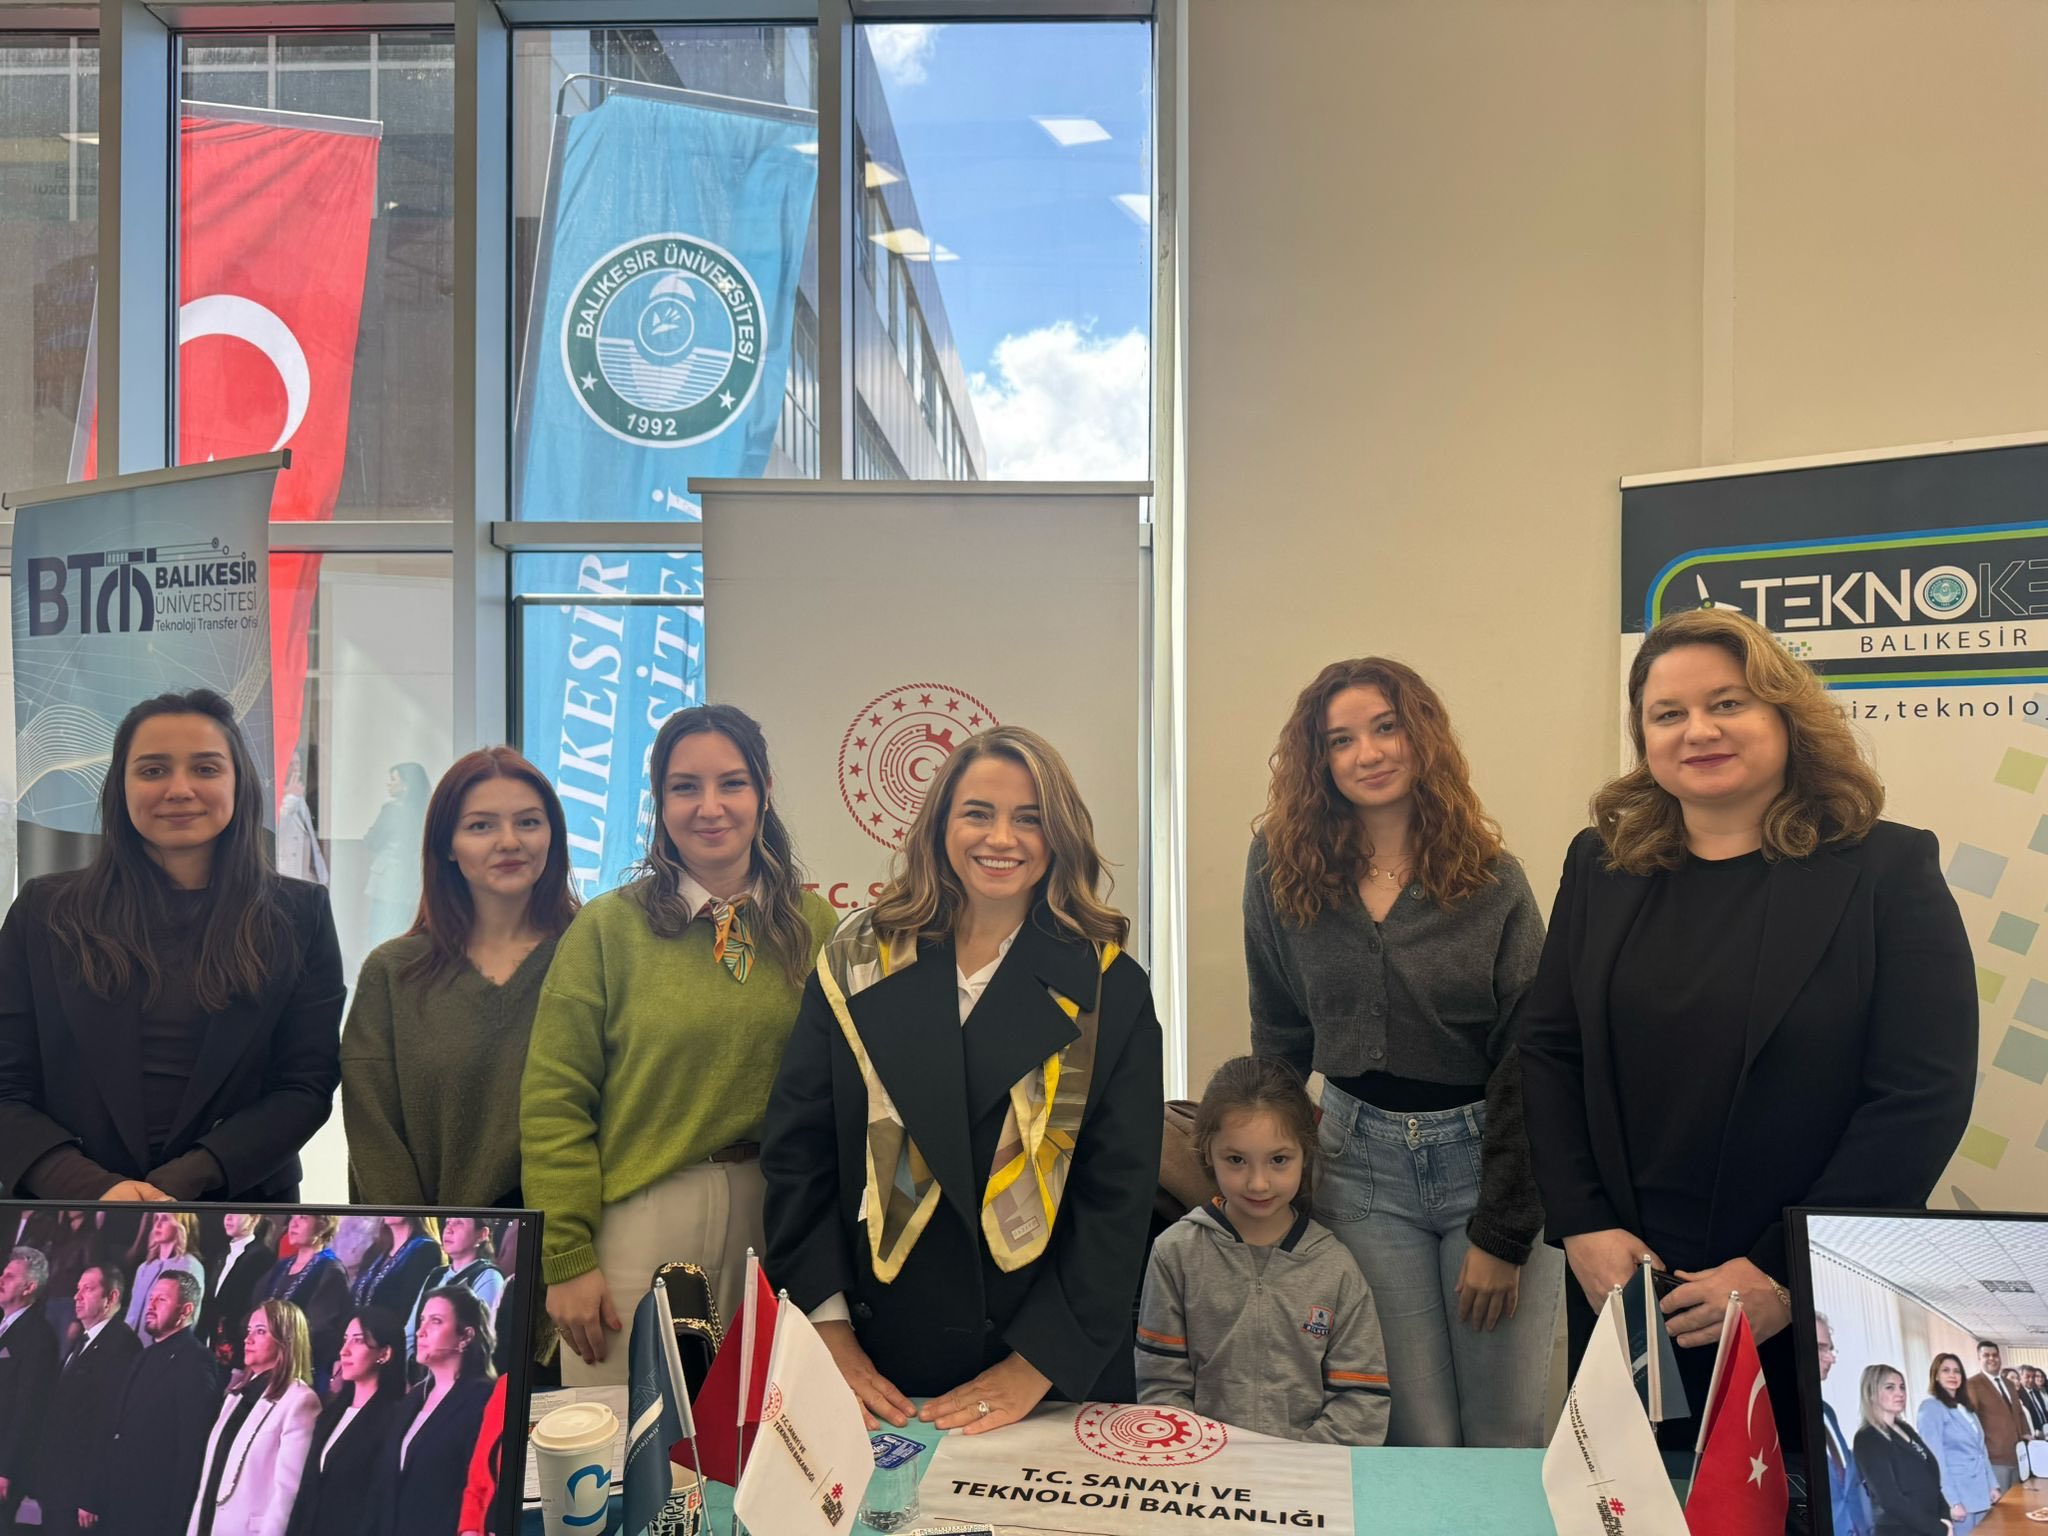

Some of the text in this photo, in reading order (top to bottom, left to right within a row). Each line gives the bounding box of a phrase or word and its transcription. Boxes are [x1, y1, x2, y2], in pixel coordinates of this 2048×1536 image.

[576, 243, 756, 365] BALIKESİR ÜNİVERSİTESİ
[627, 413, 678, 436] 1992
[155, 559, 257, 589] BALIKESİR
[155, 586, 257, 614] ÜNİVERSİTESİ
[155, 617, 197, 633] Teknoloji
[198, 616, 238, 630] Transfer
[1861, 626, 2028, 653] BALIKESİR
[556, 553, 630, 901] ALIKESİR
[1581, 1428, 1589, 1440] VE
[1574, 1429, 1596, 1473] BAKANLIĞI
[1020, 1467, 1252, 1502] T.C. SANAYİ VE
[950, 1480, 1325, 1529] TEKNOLOJİ BAKANLIĞI
